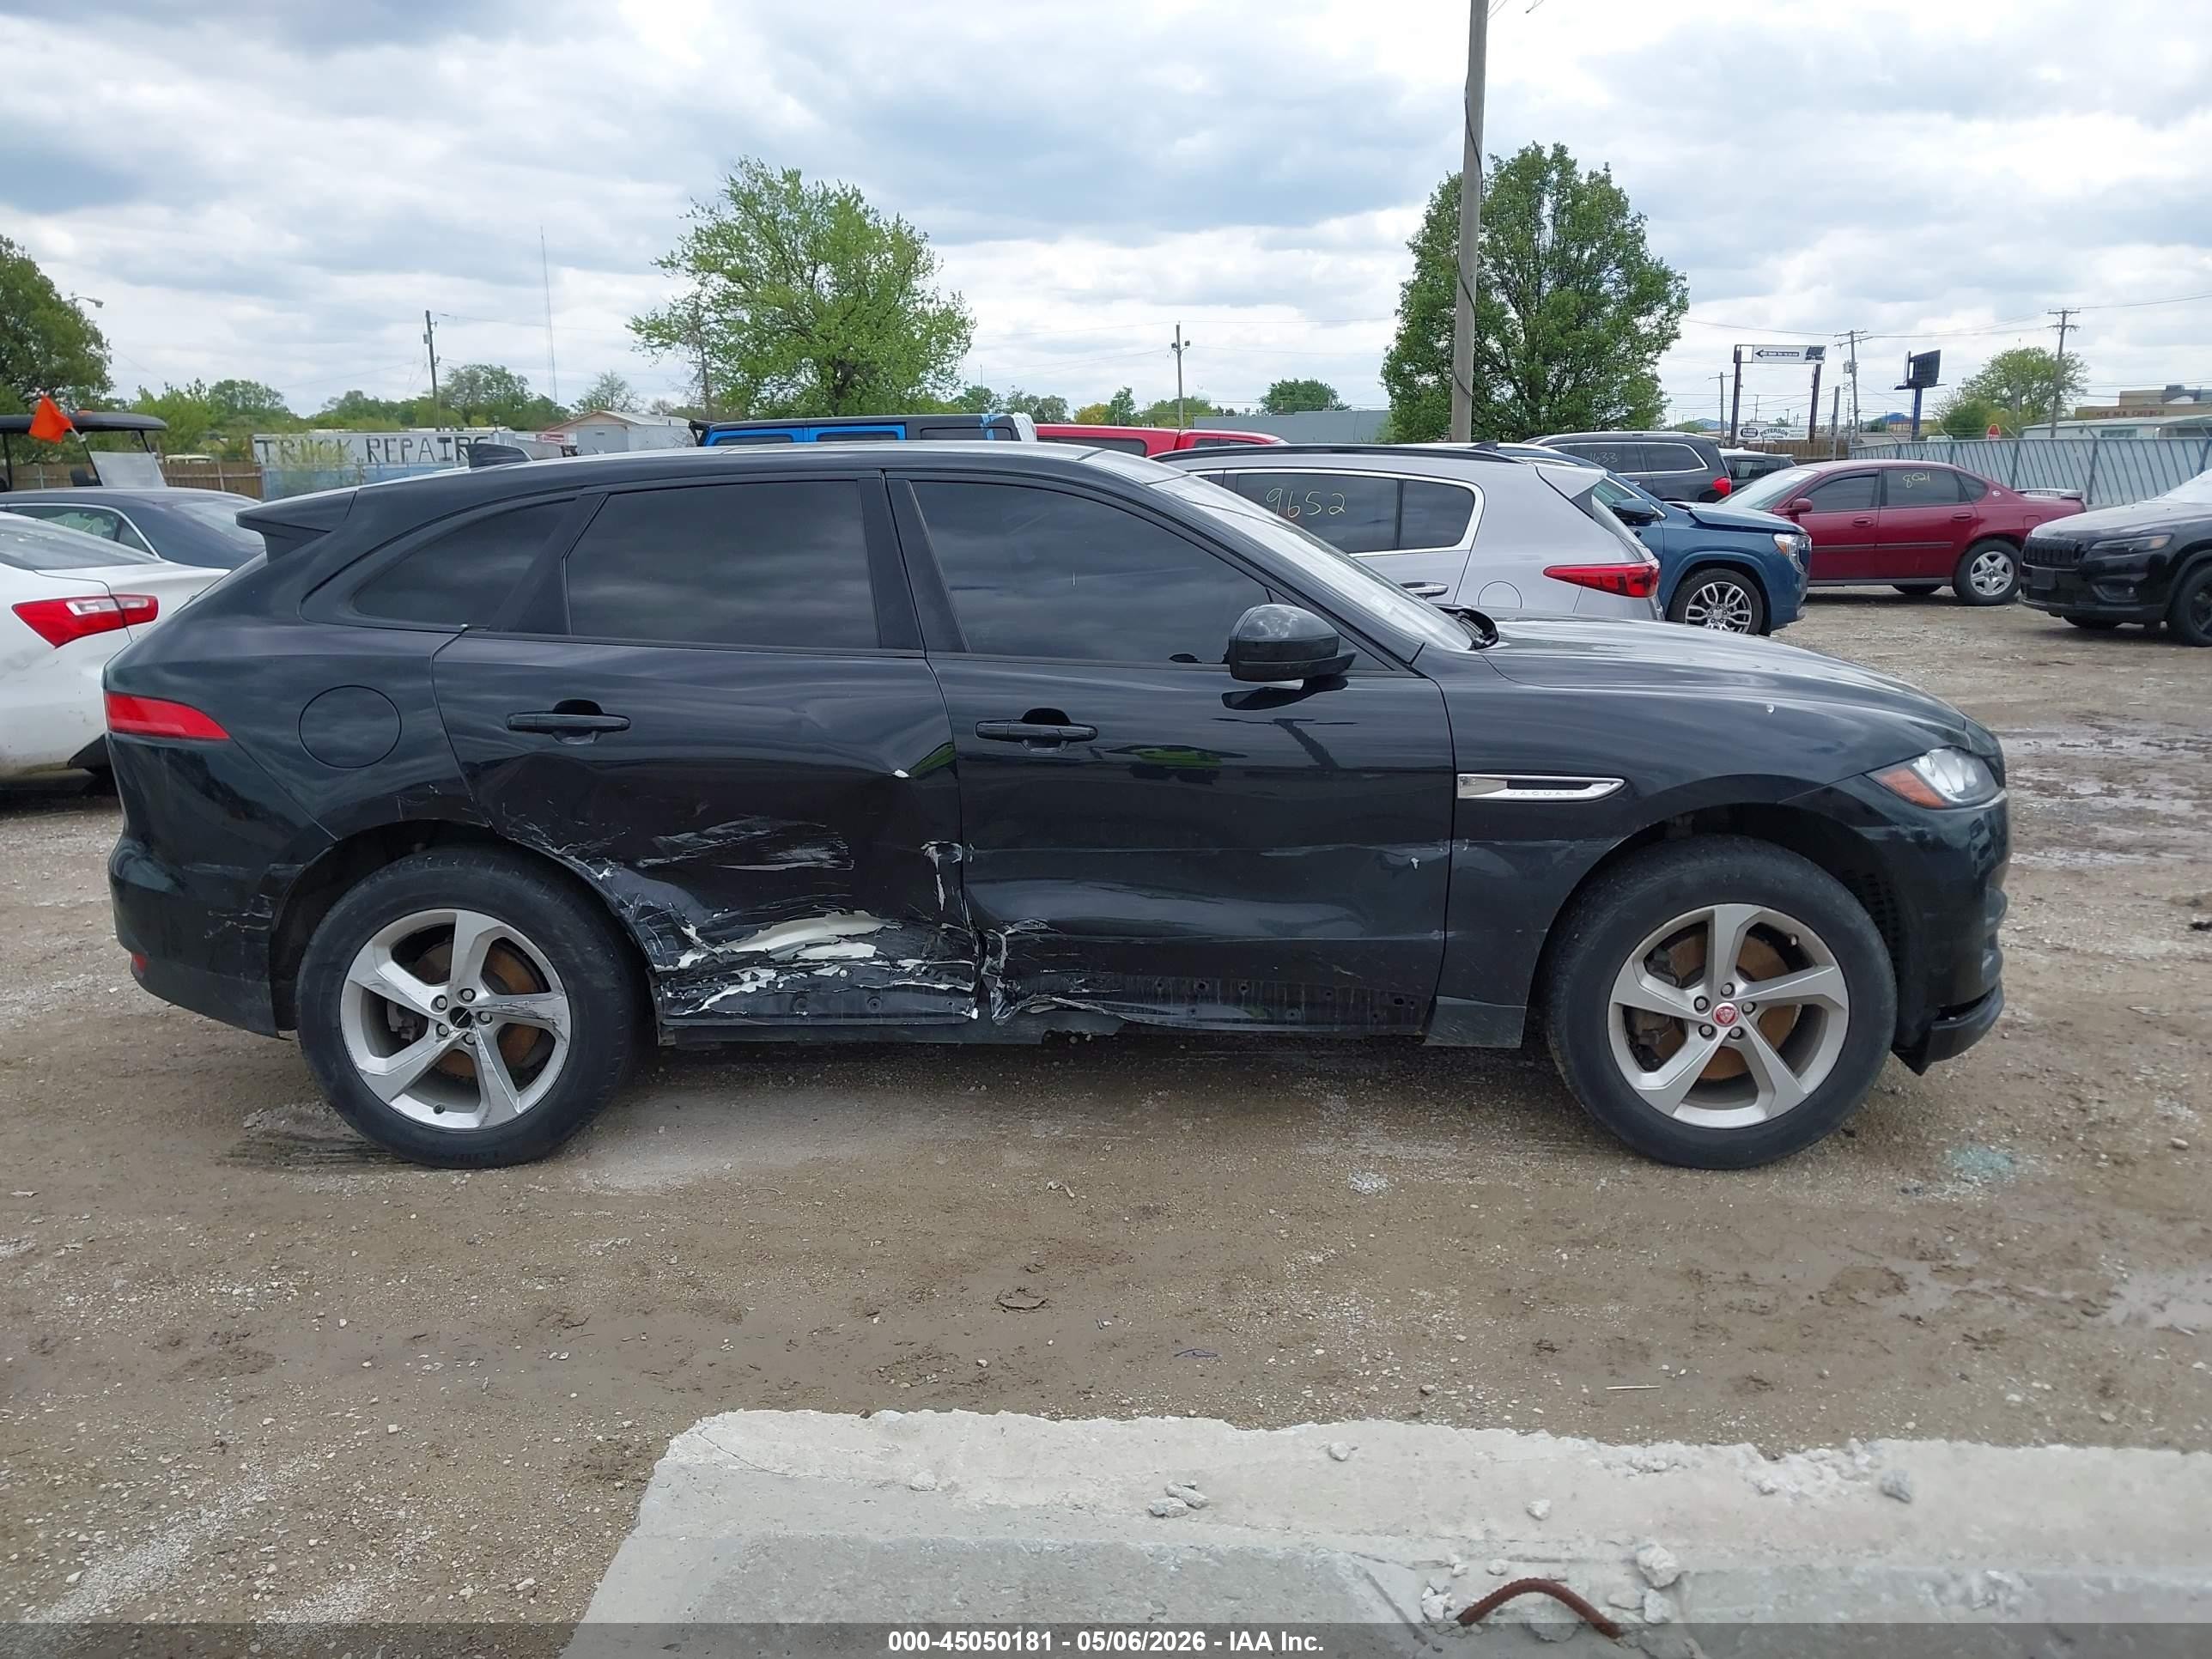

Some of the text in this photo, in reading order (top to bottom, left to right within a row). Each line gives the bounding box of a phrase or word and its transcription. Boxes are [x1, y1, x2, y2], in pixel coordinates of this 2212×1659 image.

[1759, 428, 1789, 436] PETERSON
[366, 436, 489, 463] REPAIR
[1266, 488, 1346, 519] 9652
